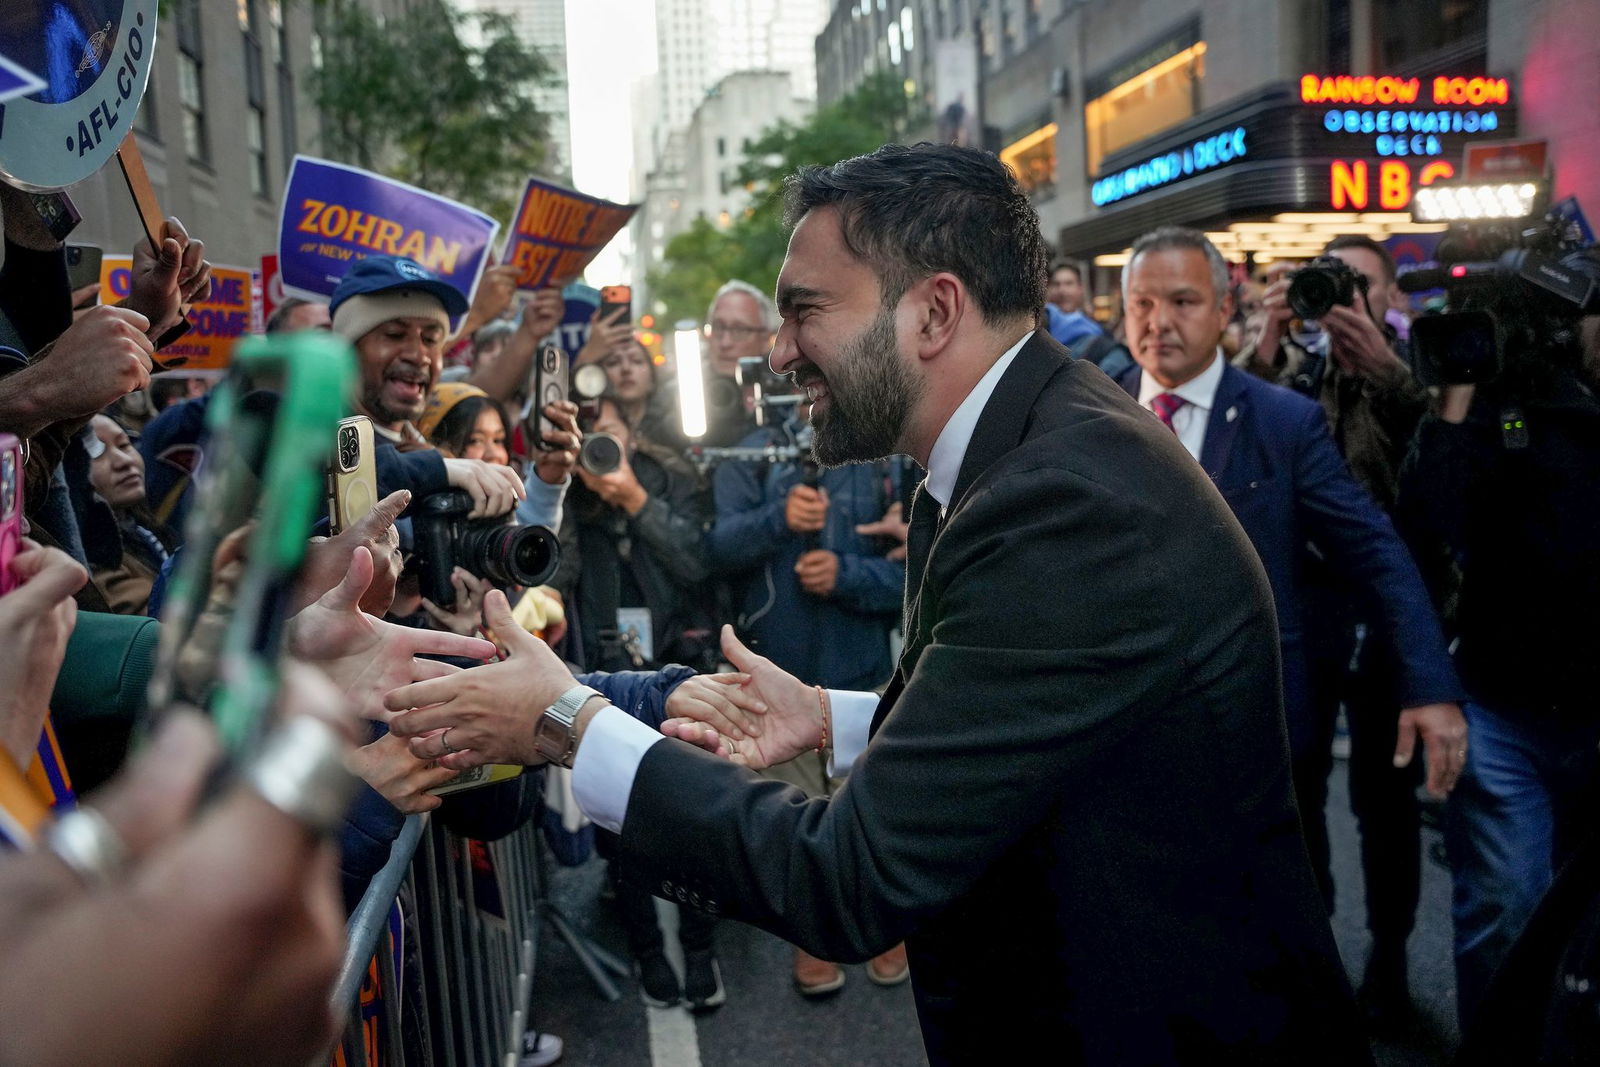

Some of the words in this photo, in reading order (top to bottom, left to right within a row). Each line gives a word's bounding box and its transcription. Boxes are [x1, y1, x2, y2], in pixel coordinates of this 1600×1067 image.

[78, 28, 143, 158] AFL-CIO
[1300, 74, 1420, 105] RAINBOW
[1433, 75, 1509, 106] ROOM
[1323, 109, 1498, 133] OBSERVATION
[1193, 126, 1246, 170] DECK
[1375, 133, 1442, 156] DECK
[297, 199, 462, 275] ZOHRAN
[318, 243, 353, 261] NEW
